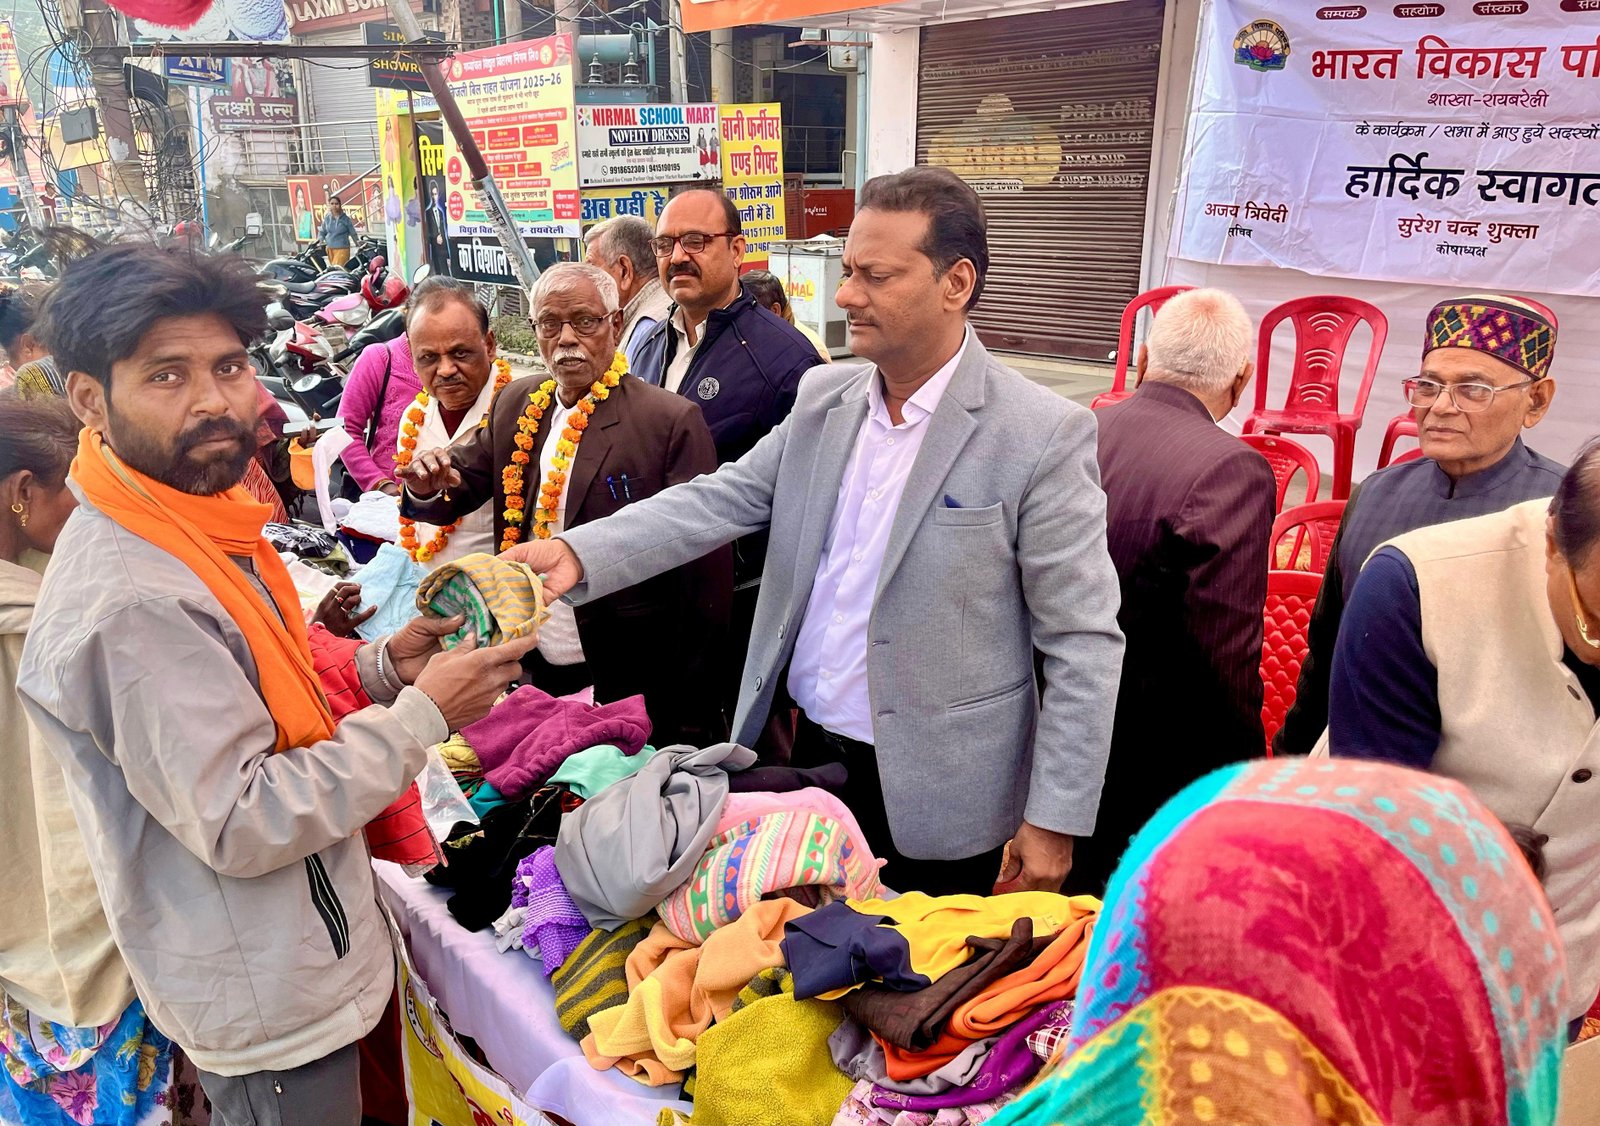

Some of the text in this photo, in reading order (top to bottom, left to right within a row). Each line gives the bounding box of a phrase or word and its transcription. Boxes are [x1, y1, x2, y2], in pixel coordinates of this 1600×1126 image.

[1322, 7, 1361, 19] सम्पर्क
[1477, 1, 1523, 14] संस्कार
[178, 57, 223, 72] ATM
[373, 59, 423, 74] SHOWR
[1311, 49, 1404, 80] भारत
[1415, 34, 1548, 79] विकास
[469, 81, 481, 96] बिल
[482, 81, 498, 95] राहत
[499, 76, 521, 92] योजना
[523, 72, 562, 89] 2025-26
[213, 97, 295, 118] लक्ष्मी सन्स
[1427, 89, 1550, 108] शाखा-रायबरेली
[592, 106, 716, 126] NIRMAL SCHOOL MART
[721, 108, 780, 141] बानी फर्नीचर
[611, 128, 689, 143] NOVELTY DRESSES
[1355, 121, 1371, 137] के
[1372, 121, 1428, 138] कार्यक्रम
[1444, 124, 1474, 138] सभा
[1476, 121, 1491, 138] में
[1492, 125, 1521, 142] आए
[1521, 123, 1546, 144] हुये
[609, 165, 646, 175] 9918652309
[729, 145, 779, 177] एण्ड गिफ्ट
[1345, 151, 1465, 201] हार्दिक
[726, 187, 737, 200] का
[764, 182, 782, 198] आगे
[581, 198, 611, 219] अब
[614, 190, 648, 217] यहीं
[756, 204, 764, 221] में
[764, 204, 775, 220] है।
[1204, 201, 1289, 223] अजय त्रिवेदी
[530, 226, 564, 234] रायबरेली
[1227, 223, 1253, 239] सचिव
[1397, 213, 1540, 244] सुरेश चन्द्र शुक्ला
[457, 243, 473, 273] का
[472, 236, 508, 276] विशाल
[1435, 241, 1489, 258] कोषाध्यक्ष
[784, 282, 813, 298] AMAL
